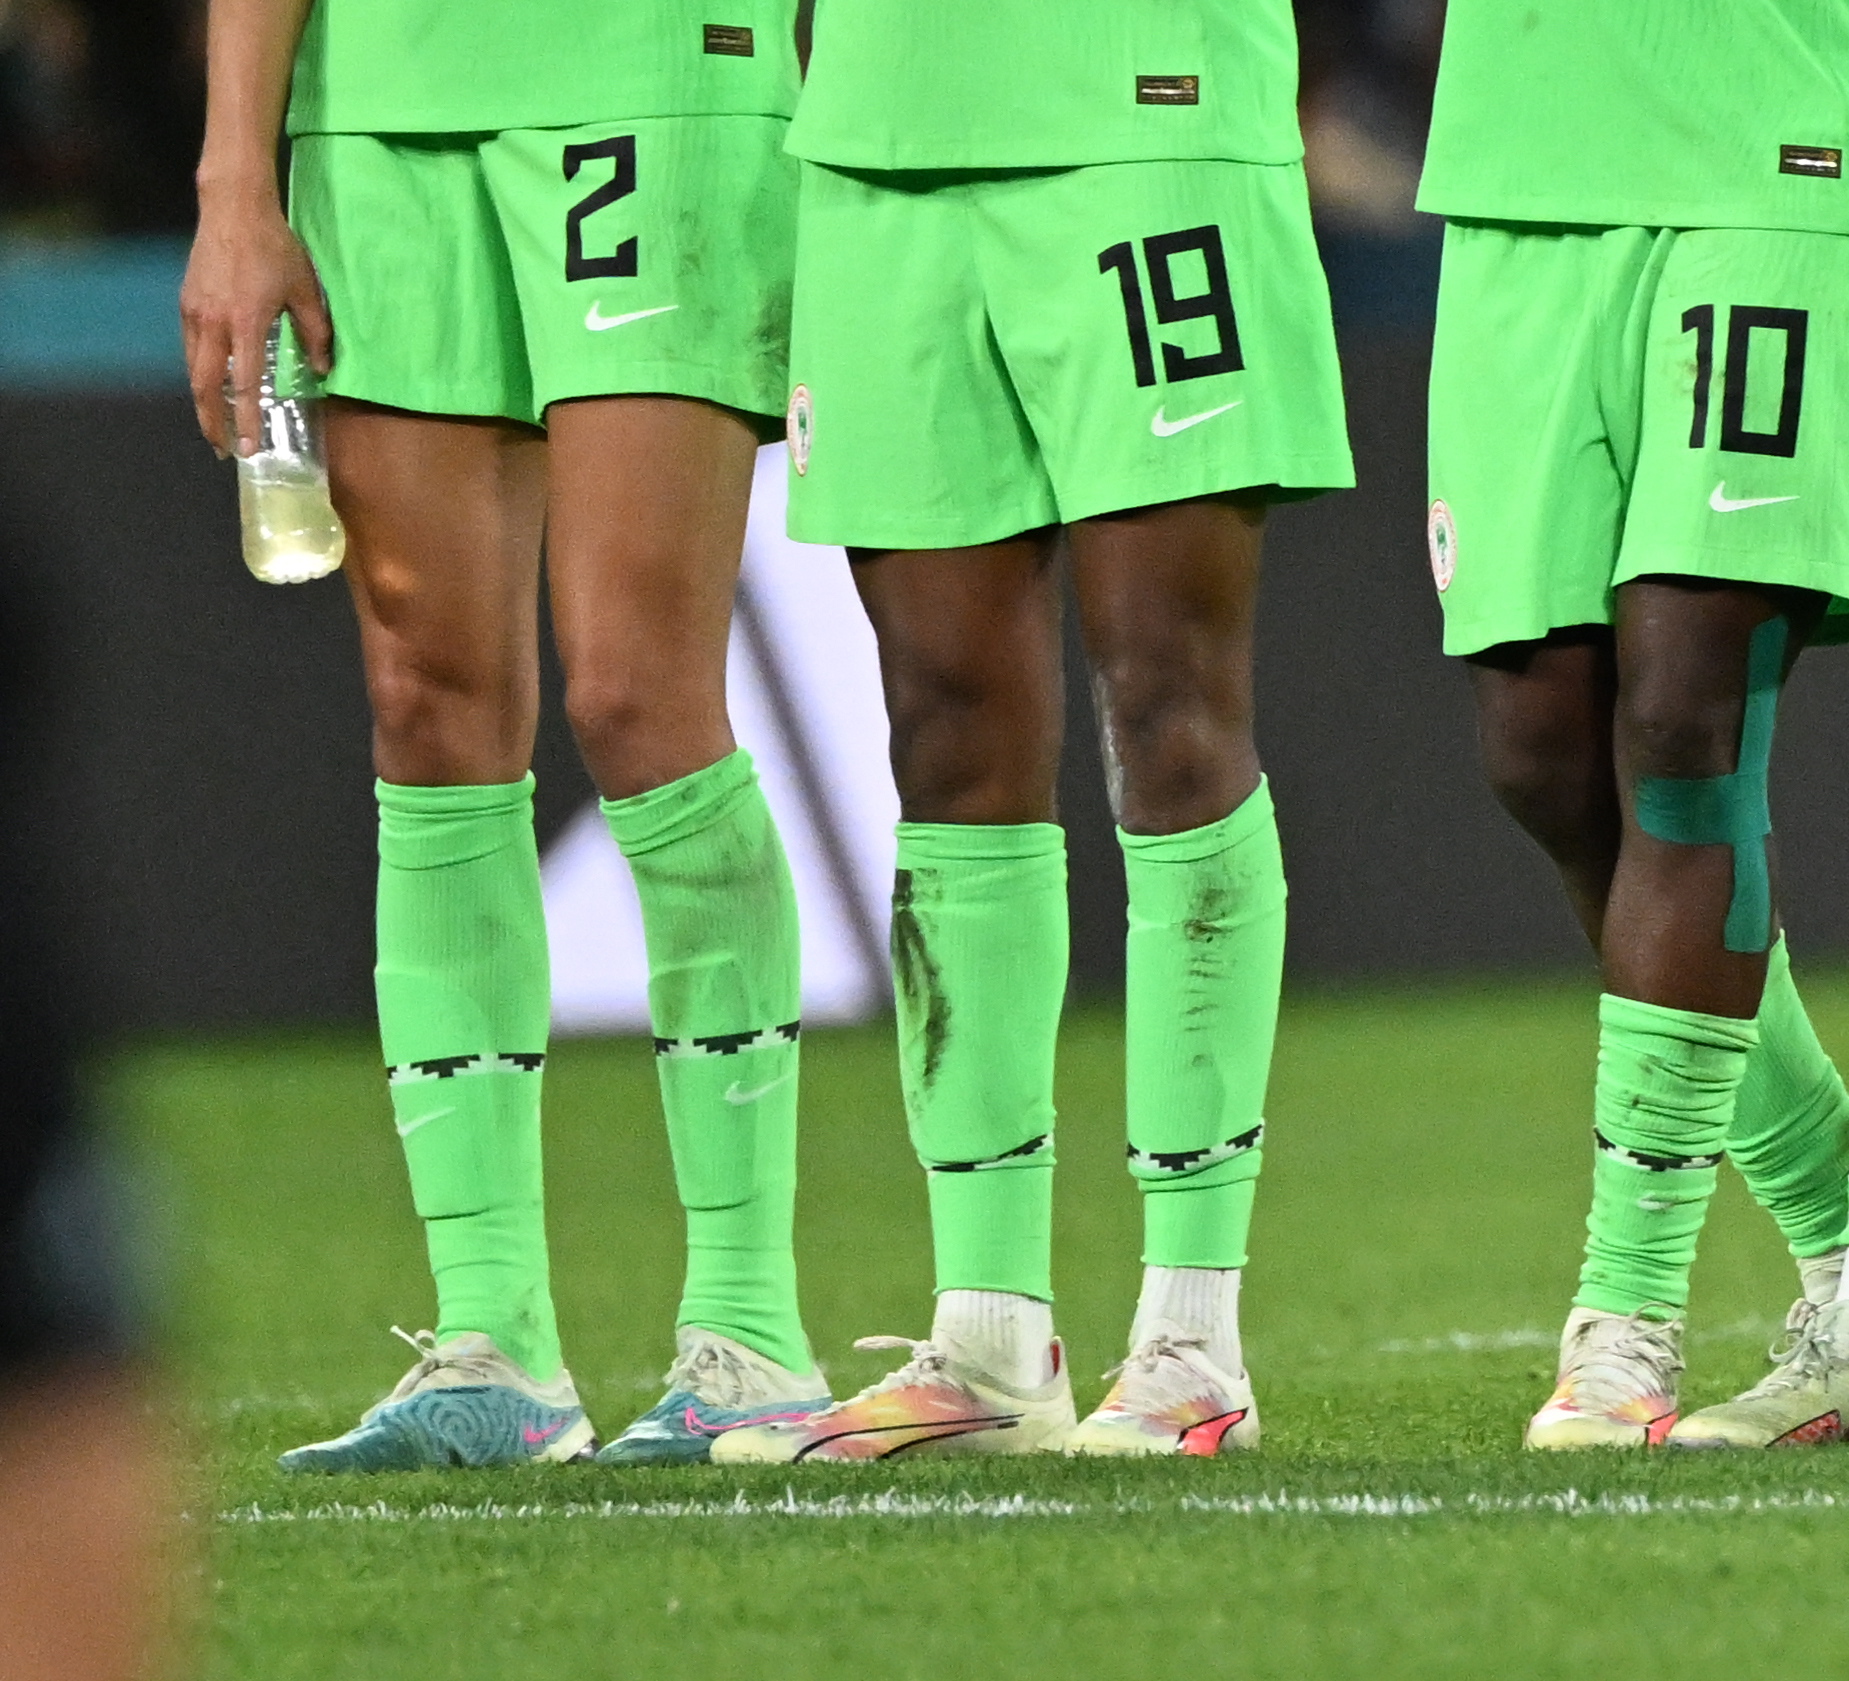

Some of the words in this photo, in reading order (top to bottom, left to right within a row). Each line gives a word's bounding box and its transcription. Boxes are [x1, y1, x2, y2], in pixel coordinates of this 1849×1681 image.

[563, 135, 638, 283] 2
[1097, 224, 1246, 387] 19
[1681, 304, 1808, 458] 10
